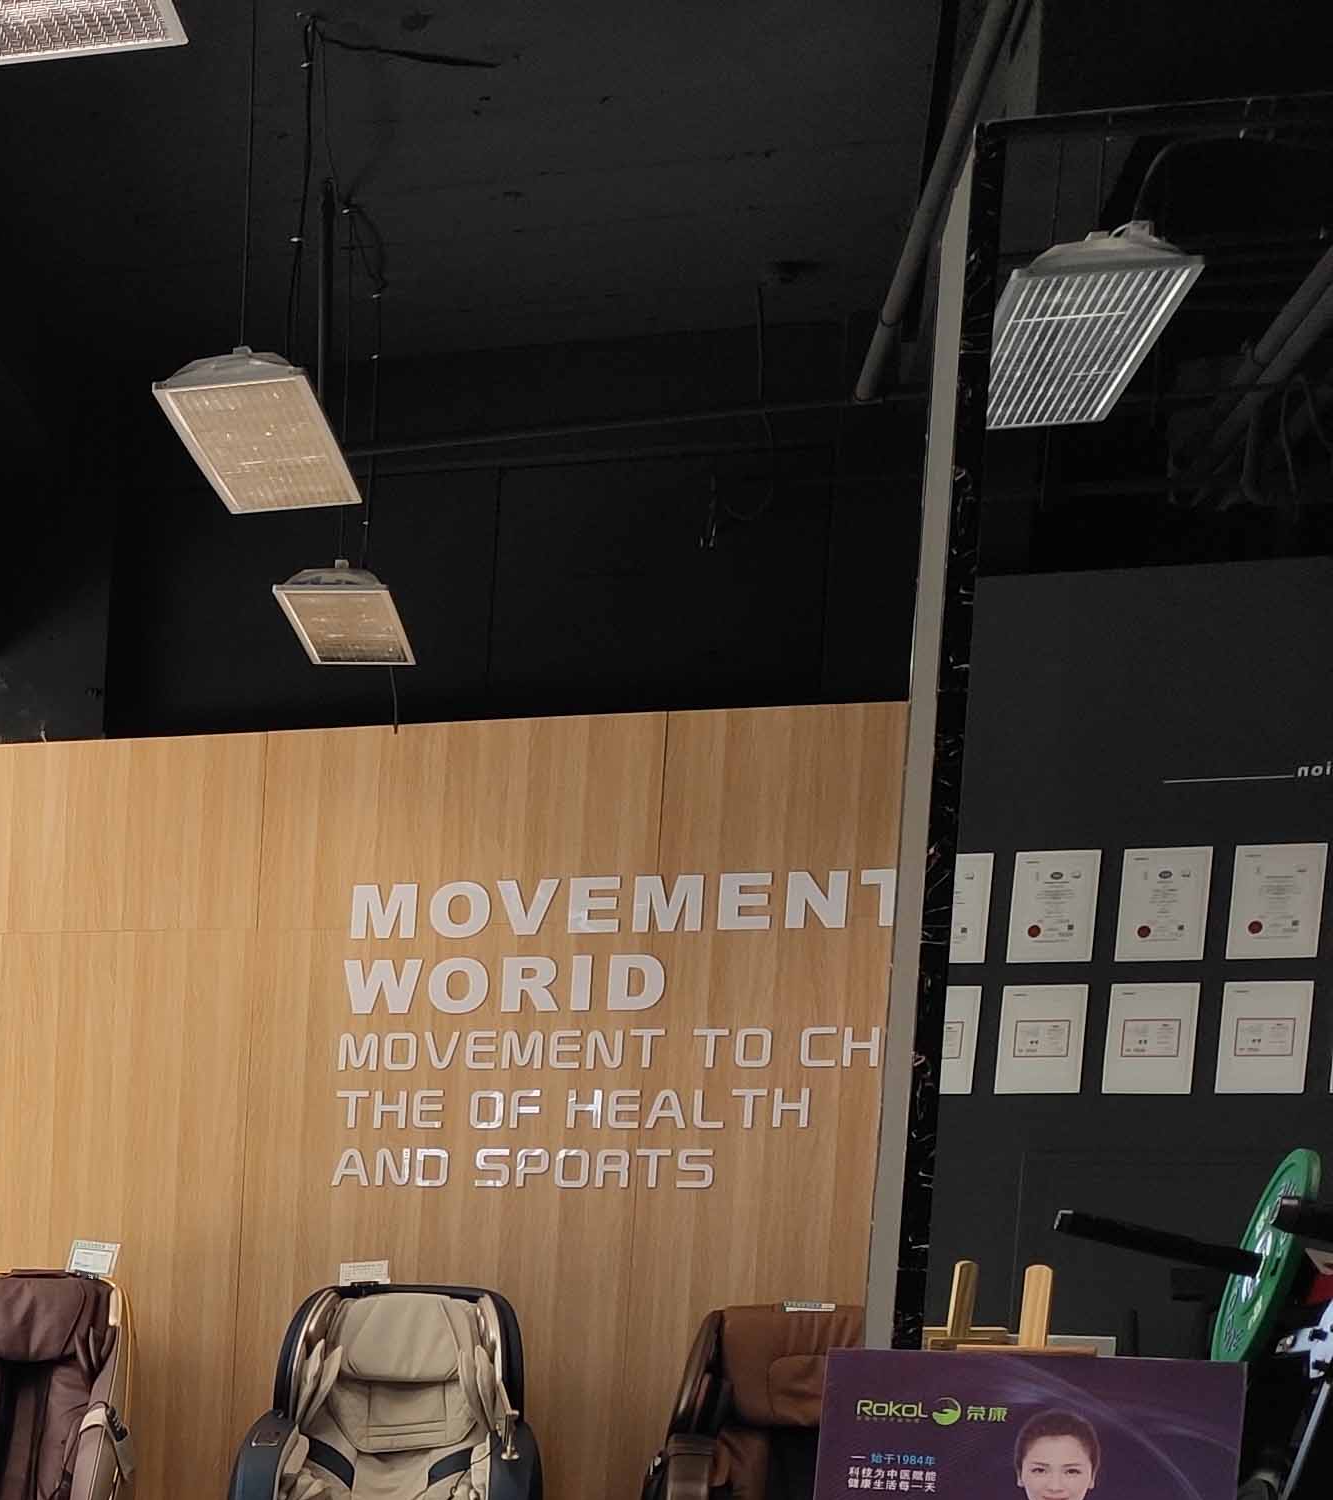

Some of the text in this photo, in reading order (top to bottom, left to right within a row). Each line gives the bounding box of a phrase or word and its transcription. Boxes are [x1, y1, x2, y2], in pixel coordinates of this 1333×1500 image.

[349, 867, 896, 940] MOVEMENT
[336, 1027, 665, 1071] MOVEMENT
[692, 1026, 774, 1069] TO
[336, 1087, 811, 1129] THE OF HEALTH
[332, 1147, 715, 1189] AND SPORTS
[966, 1405, 1008, 1423] 荣康
[848, 1466, 937, 1482] 科技为中医赋能
[870, 1452, 936, 1466] 始于1984年
[847, 1478, 937, 1493] 健康生活每一天
